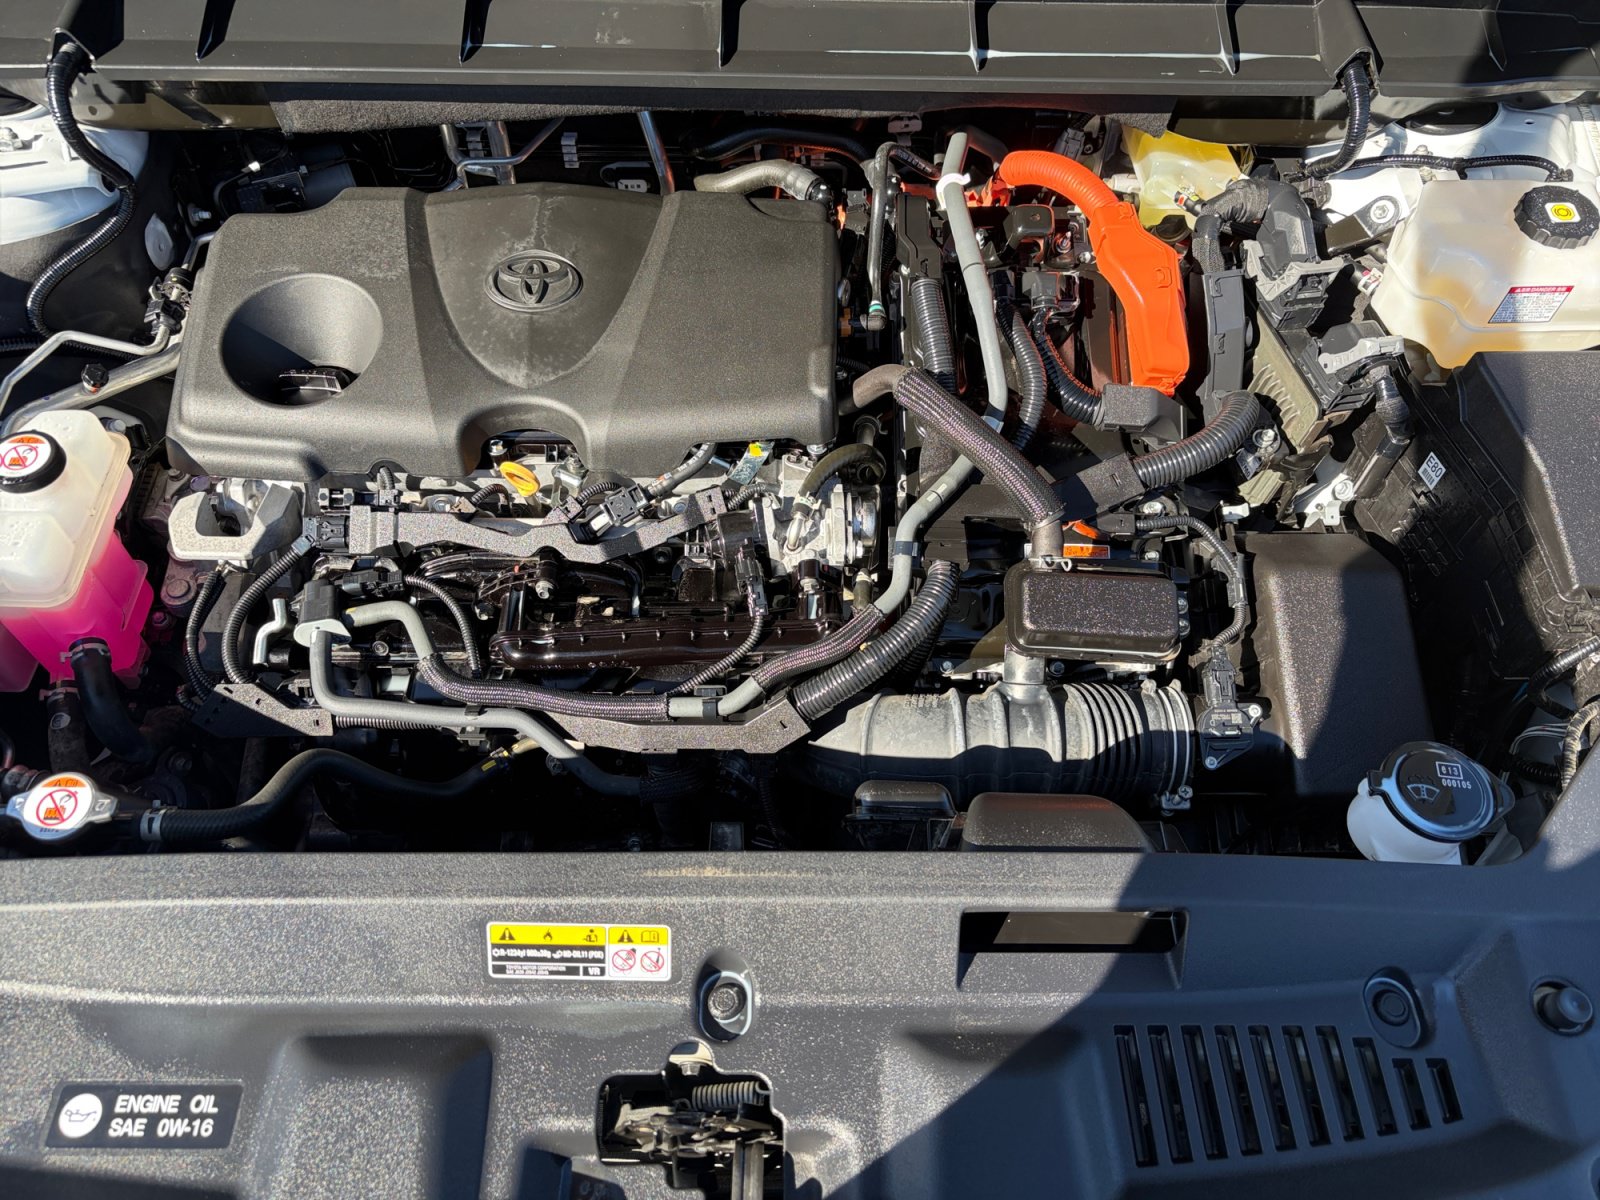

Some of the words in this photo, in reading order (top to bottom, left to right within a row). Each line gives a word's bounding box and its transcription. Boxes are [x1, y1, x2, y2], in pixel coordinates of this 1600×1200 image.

[1426, 455, 1442, 477] E80
[1442, 778, 1471, 789] 000105
[588, 967, 600, 976] VR
[114, 1094, 181, 1113] ENGINE
[190, 1094, 219, 1114] OIL
[108, 1118, 147, 1138] SAE
[156, 1118, 214, 1138] 0W-16
